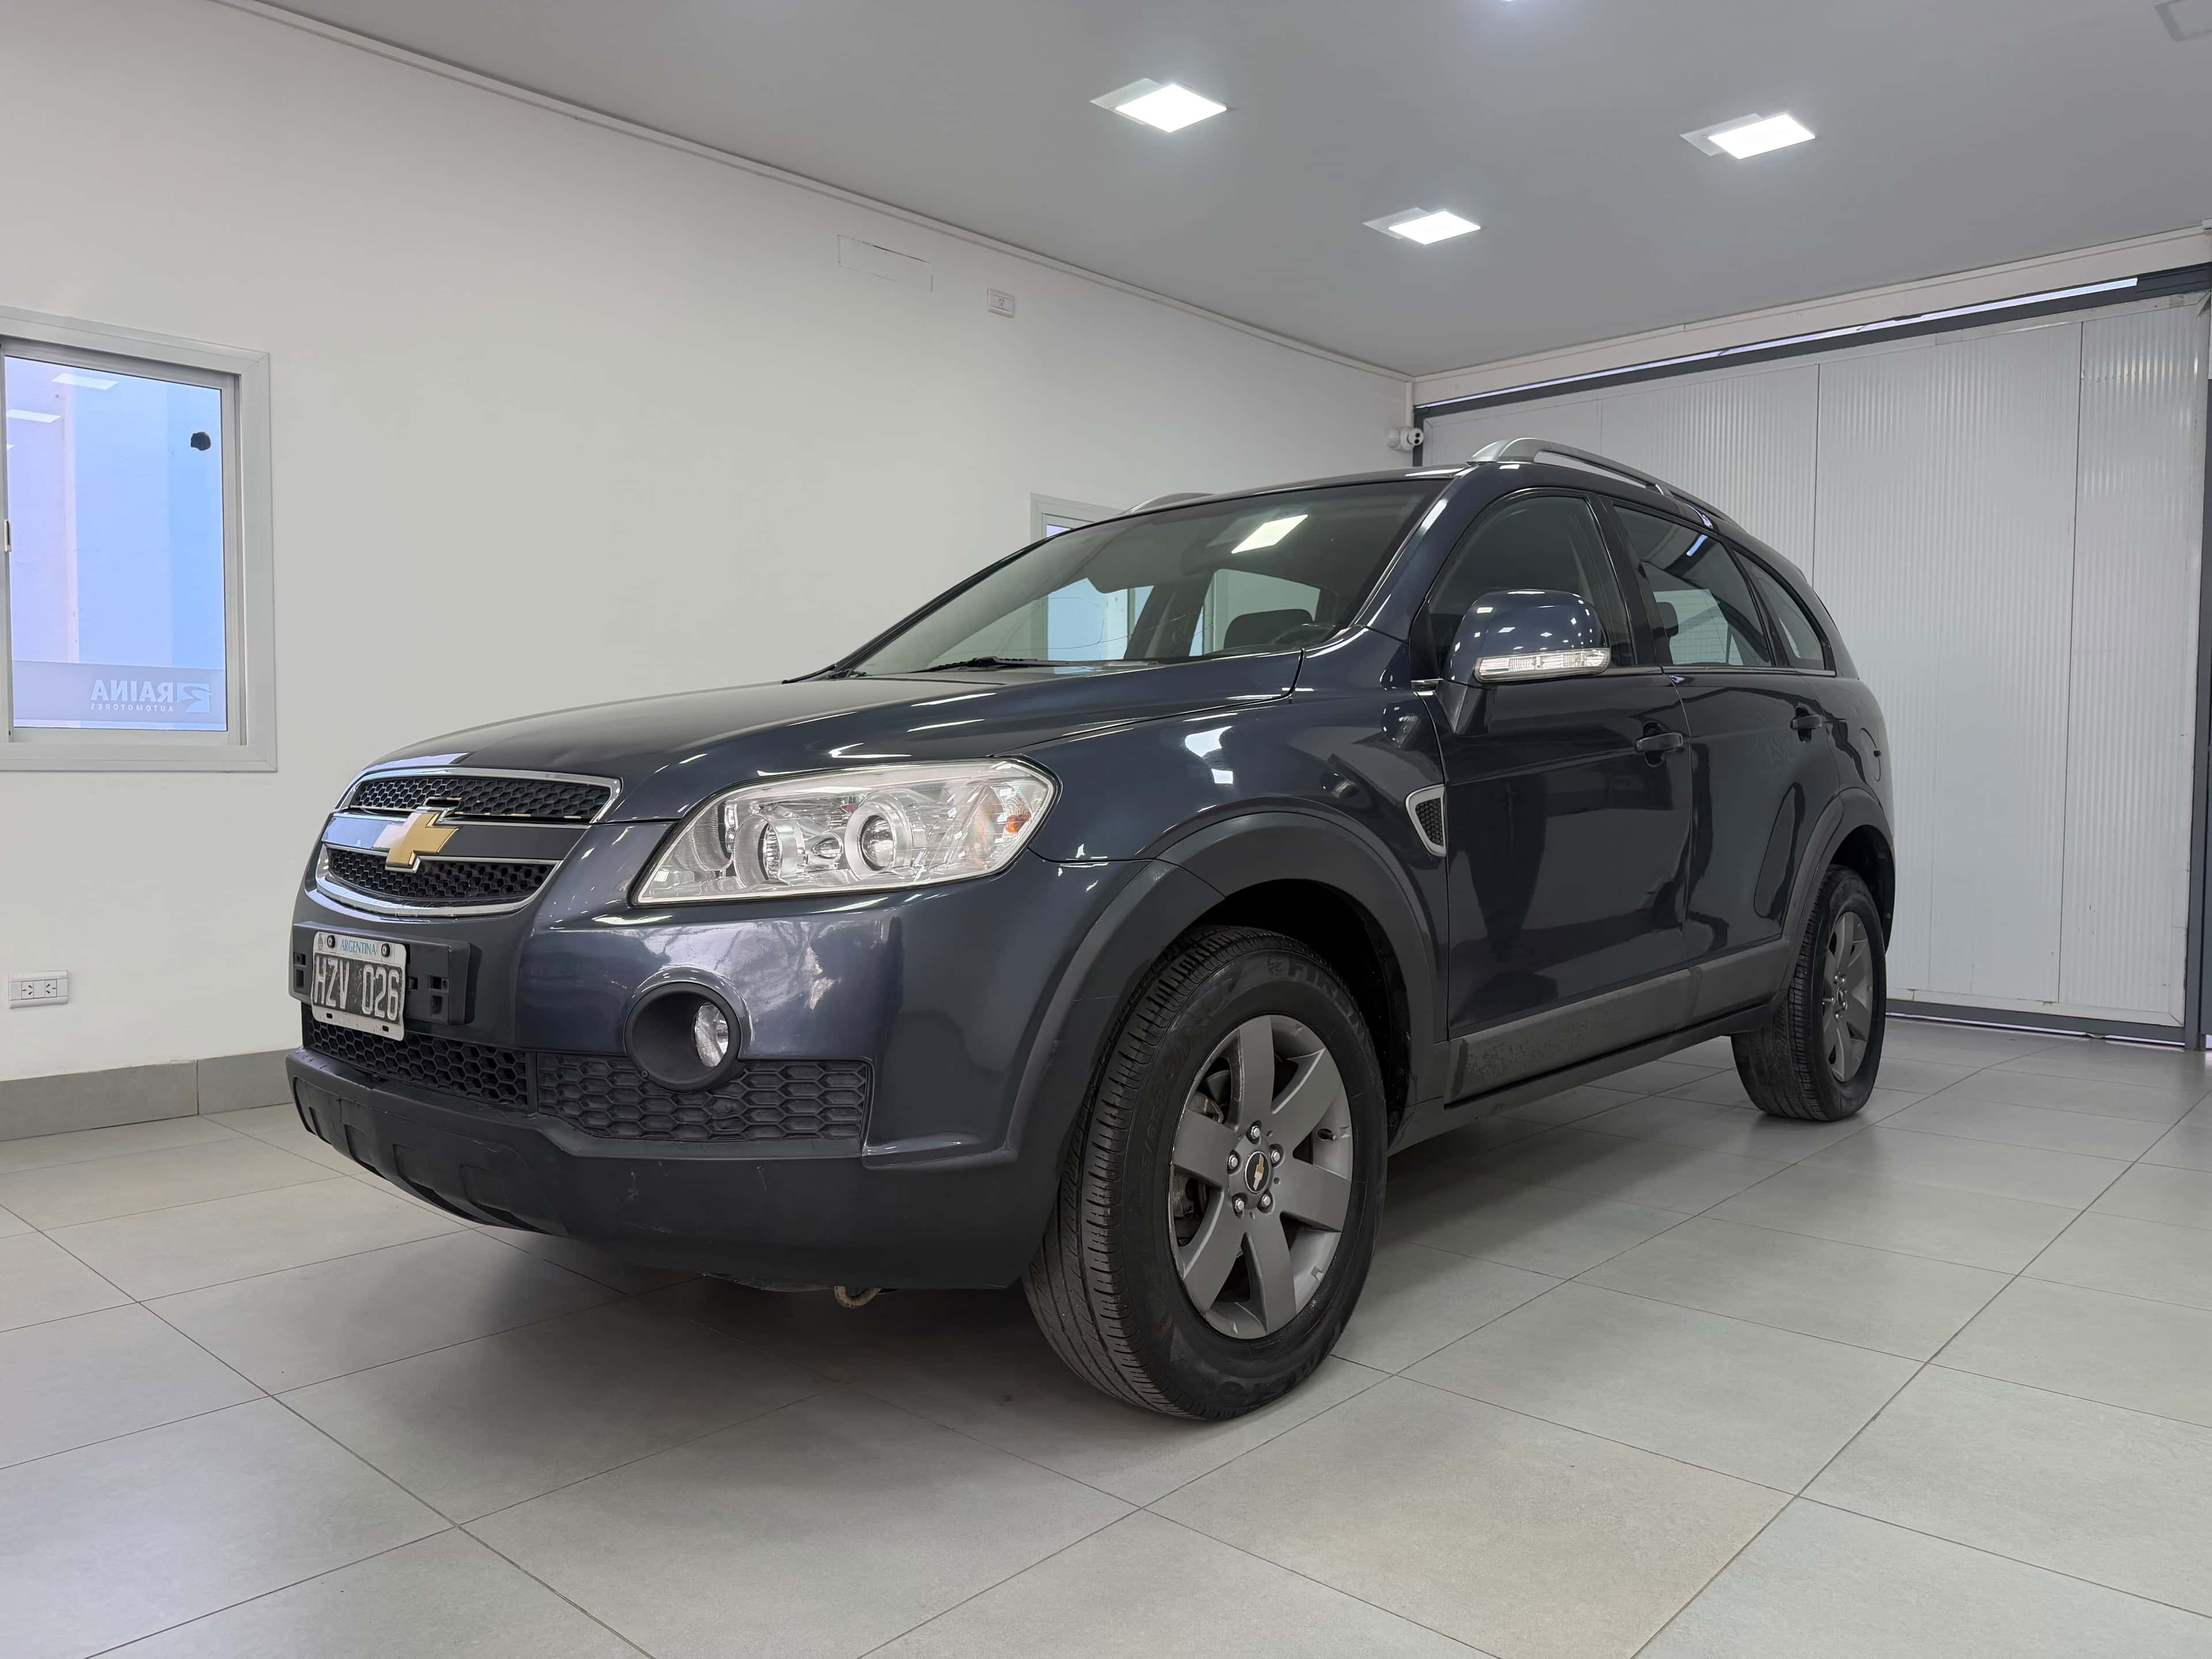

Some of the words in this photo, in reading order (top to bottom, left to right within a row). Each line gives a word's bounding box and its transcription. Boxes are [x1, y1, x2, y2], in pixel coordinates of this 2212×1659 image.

[340, 939, 377, 955] ARGENTINA
[314, 956, 350, 1010] HZV
[362, 964, 400, 1021] 026
